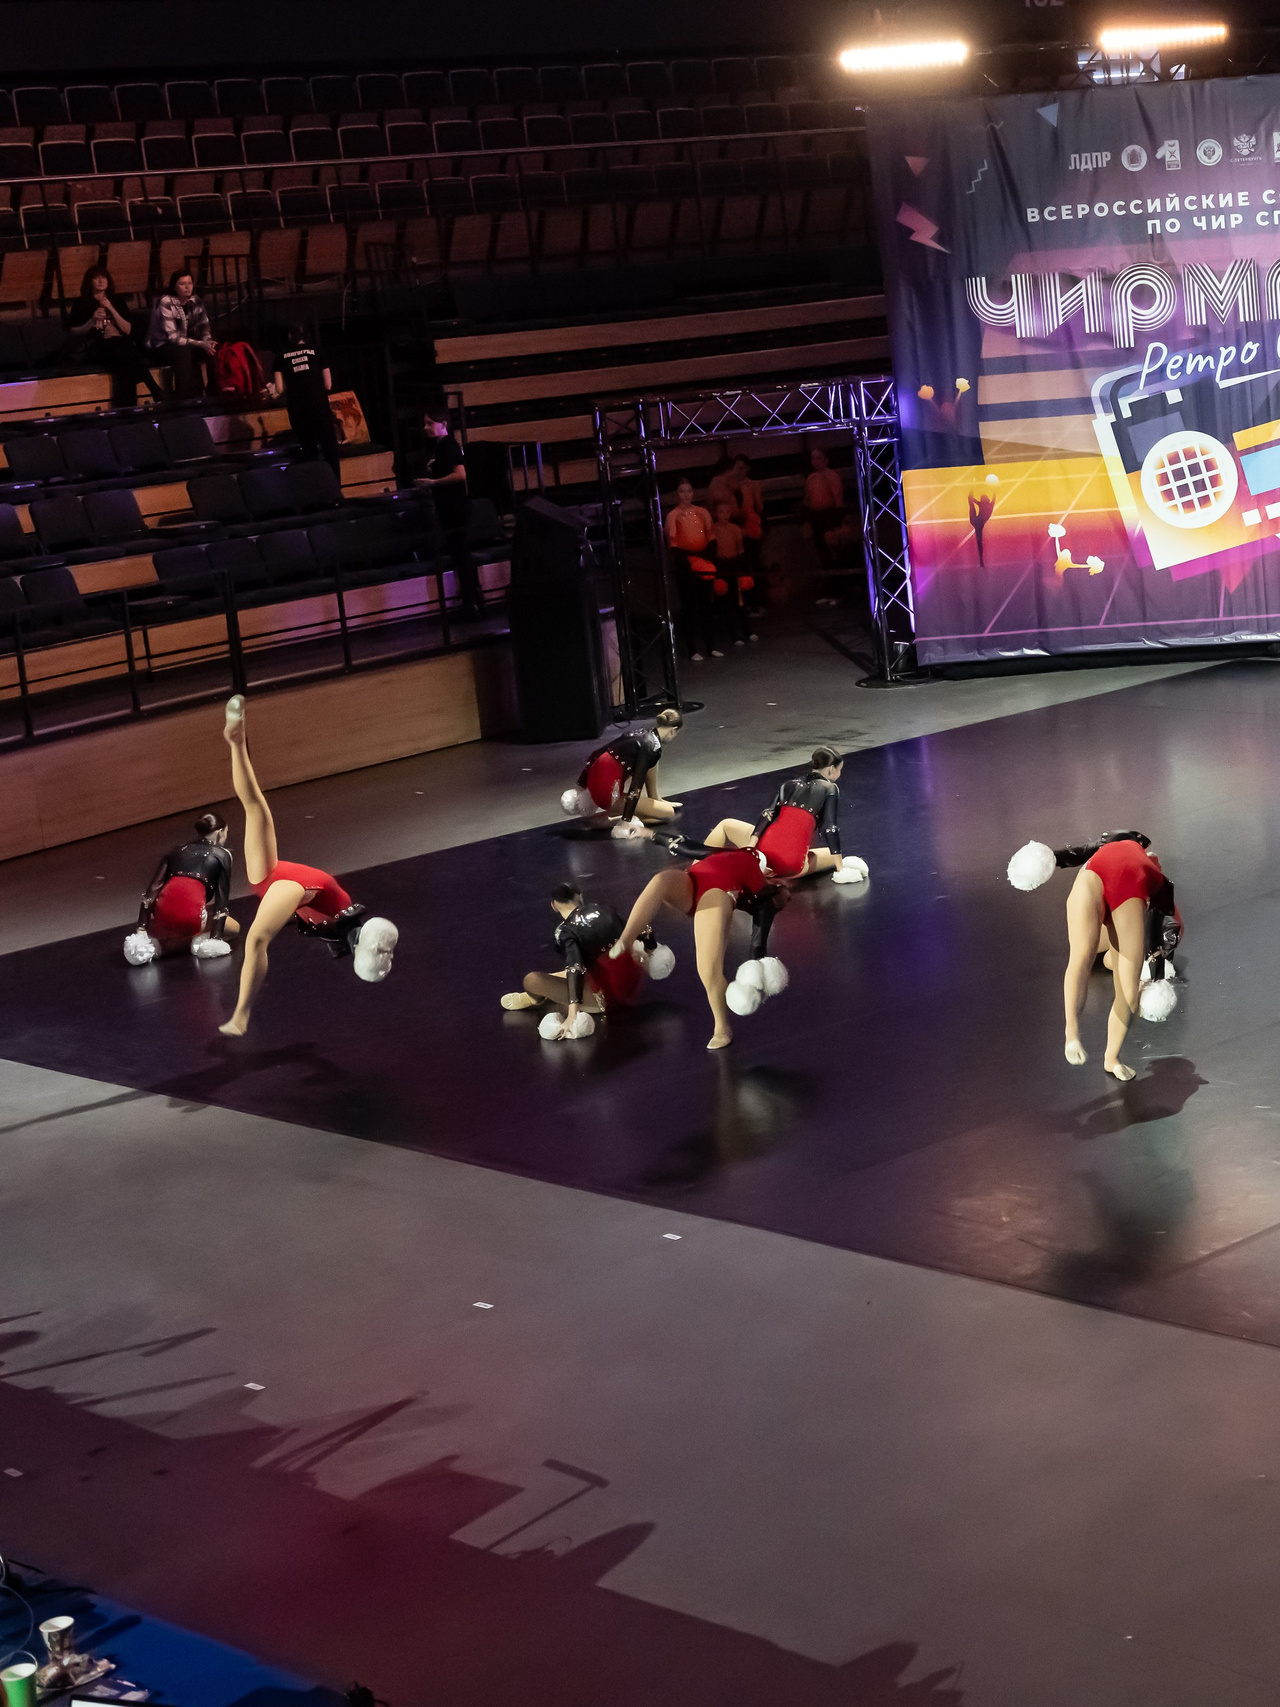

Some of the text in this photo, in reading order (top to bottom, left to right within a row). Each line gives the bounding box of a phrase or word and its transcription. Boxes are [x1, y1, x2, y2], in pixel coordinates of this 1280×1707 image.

[1068, 152, 1111, 172] ЛДПР
[1026, 192, 1250, 222] ВСЕРОССИЙСКИЕ
[1147, 218, 1181, 234] ПО
[1193, 214, 1243, 230] ЧИР
[1138, 341, 1260, 390] Ретро
